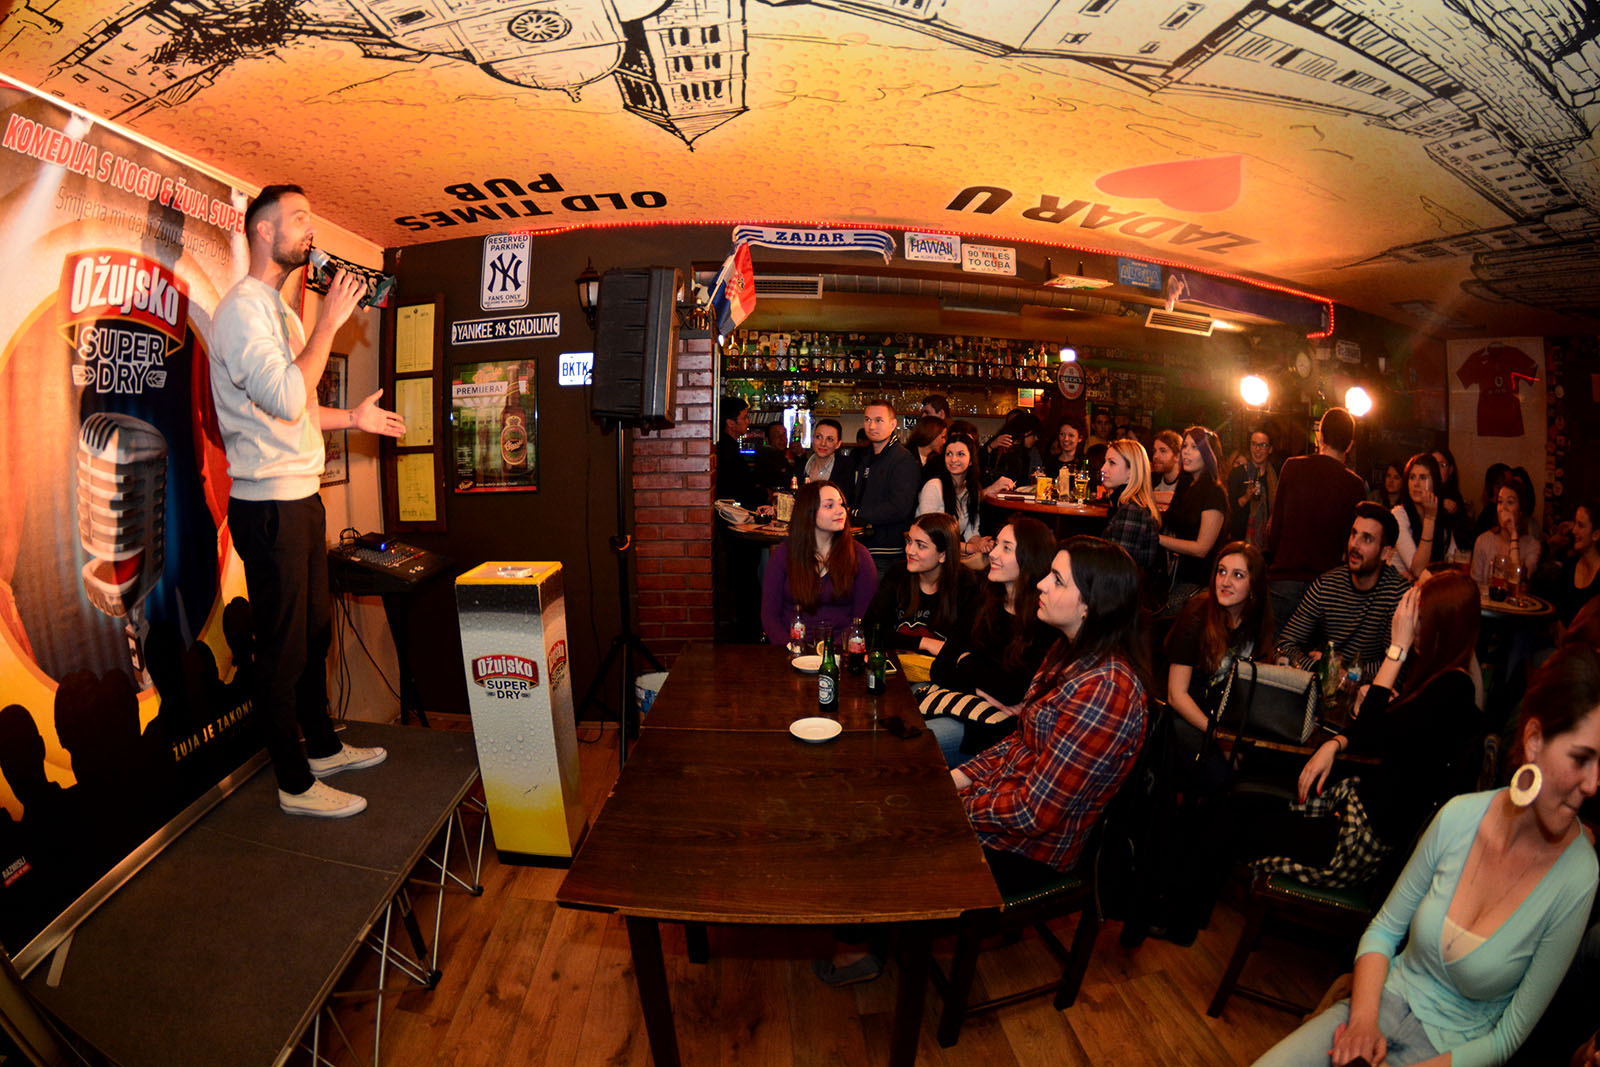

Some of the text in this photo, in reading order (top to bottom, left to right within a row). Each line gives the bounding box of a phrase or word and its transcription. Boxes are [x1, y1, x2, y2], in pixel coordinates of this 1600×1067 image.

[2, 113, 246, 235] KOMEDIJA S NOGU & ŽUJA SUPE
[443, 173, 565, 202] PUB
[394, 190, 668, 232] OLD TIMES
[945, 186, 1265, 254] ZADAR U
[488, 235, 528, 245] RESERVED
[490, 242, 525, 251] PARKING
[775, 231, 845, 243] ZADAR
[967, 250, 1010, 261] 90 MILES
[967, 258, 1011, 269] TO CUBA
[487, 252, 523, 293] NY
[70, 255, 180, 327] Ožujsko
[457, 322, 494, 340] YANKEE
[508, 317, 554, 336] STADIUM
[78, 326, 165, 366] SUPER
[96, 360, 150, 394] DRY
[477, 656, 534, 678] Ožujsko
[487, 680, 528, 691] SUPER
[497, 690, 521, 700] DRY
[203, 724, 215, 743] JE
